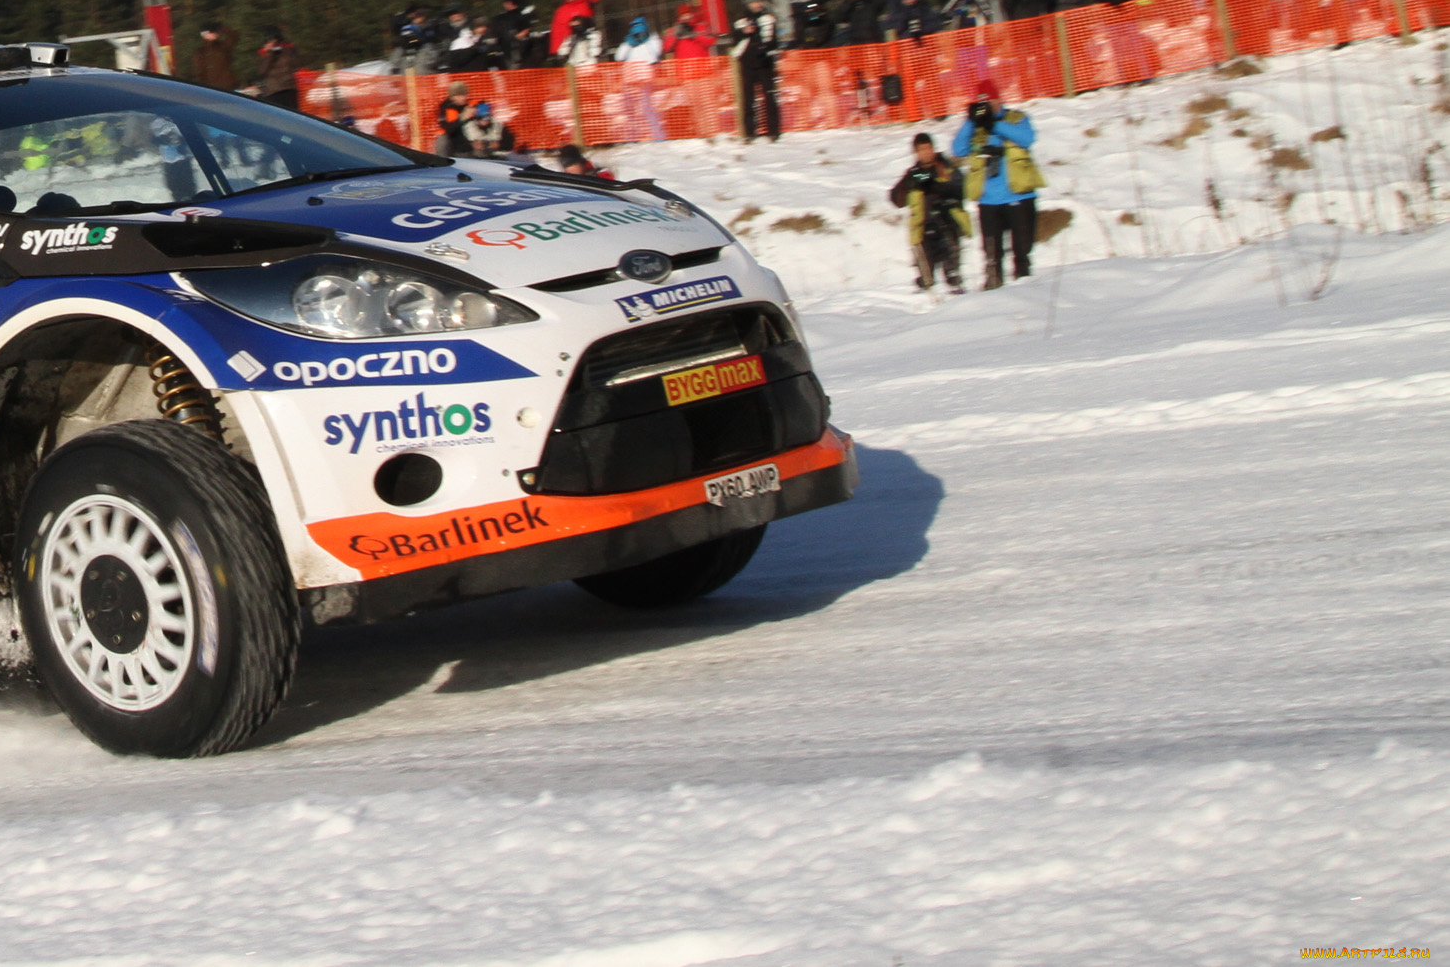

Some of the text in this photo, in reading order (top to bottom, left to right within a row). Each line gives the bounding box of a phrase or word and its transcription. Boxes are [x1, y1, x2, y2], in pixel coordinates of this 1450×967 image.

[20, 221, 119, 256] synthos
[512, 205, 681, 241] Barlinek
[632, 255, 662, 275] Ford
[651, 279, 733, 307] MICHELIN
[273, 347, 457, 386] opoczno
[324, 391, 491, 454] synthos
[389, 500, 550, 557] Barlinek
